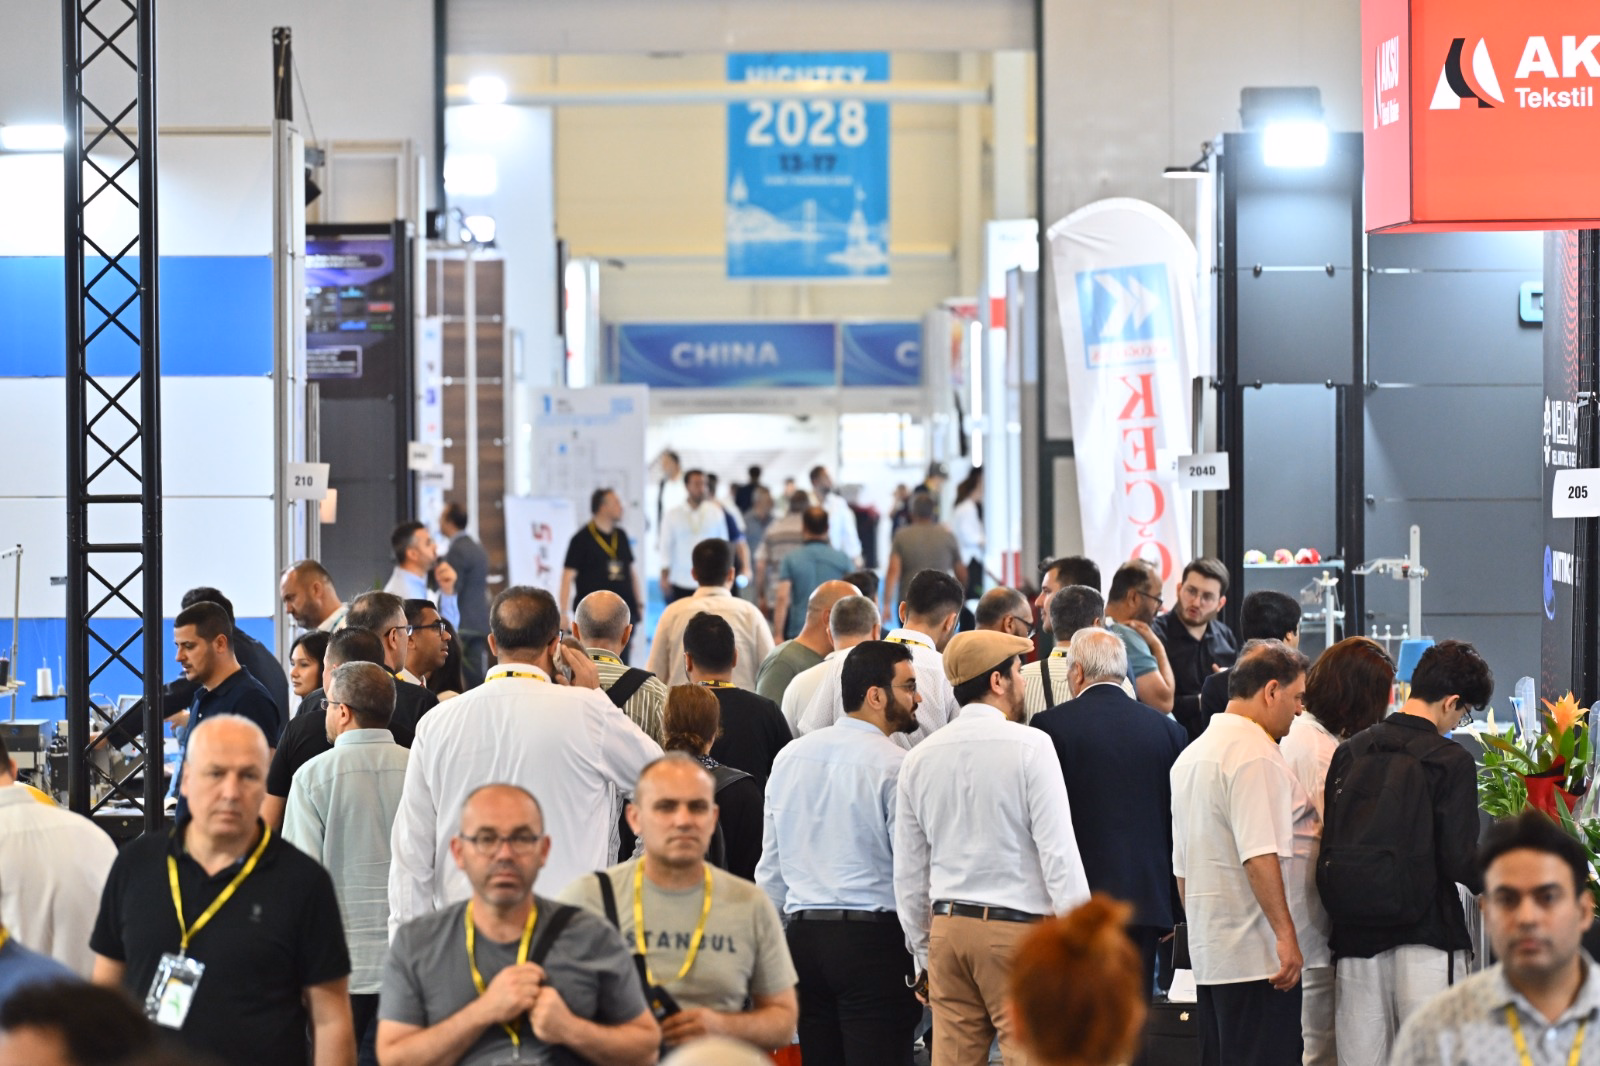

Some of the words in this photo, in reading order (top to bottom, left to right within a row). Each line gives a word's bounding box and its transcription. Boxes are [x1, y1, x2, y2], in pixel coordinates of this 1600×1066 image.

[1514, 86, 1593, 108] Tekstil
[746, 100, 868, 147] 2028
[670, 341, 779, 368] CHINA
[1189, 465, 1216, 477] 204D
[295, 476, 313, 487] 210
[1568, 486, 1588, 499] 205
